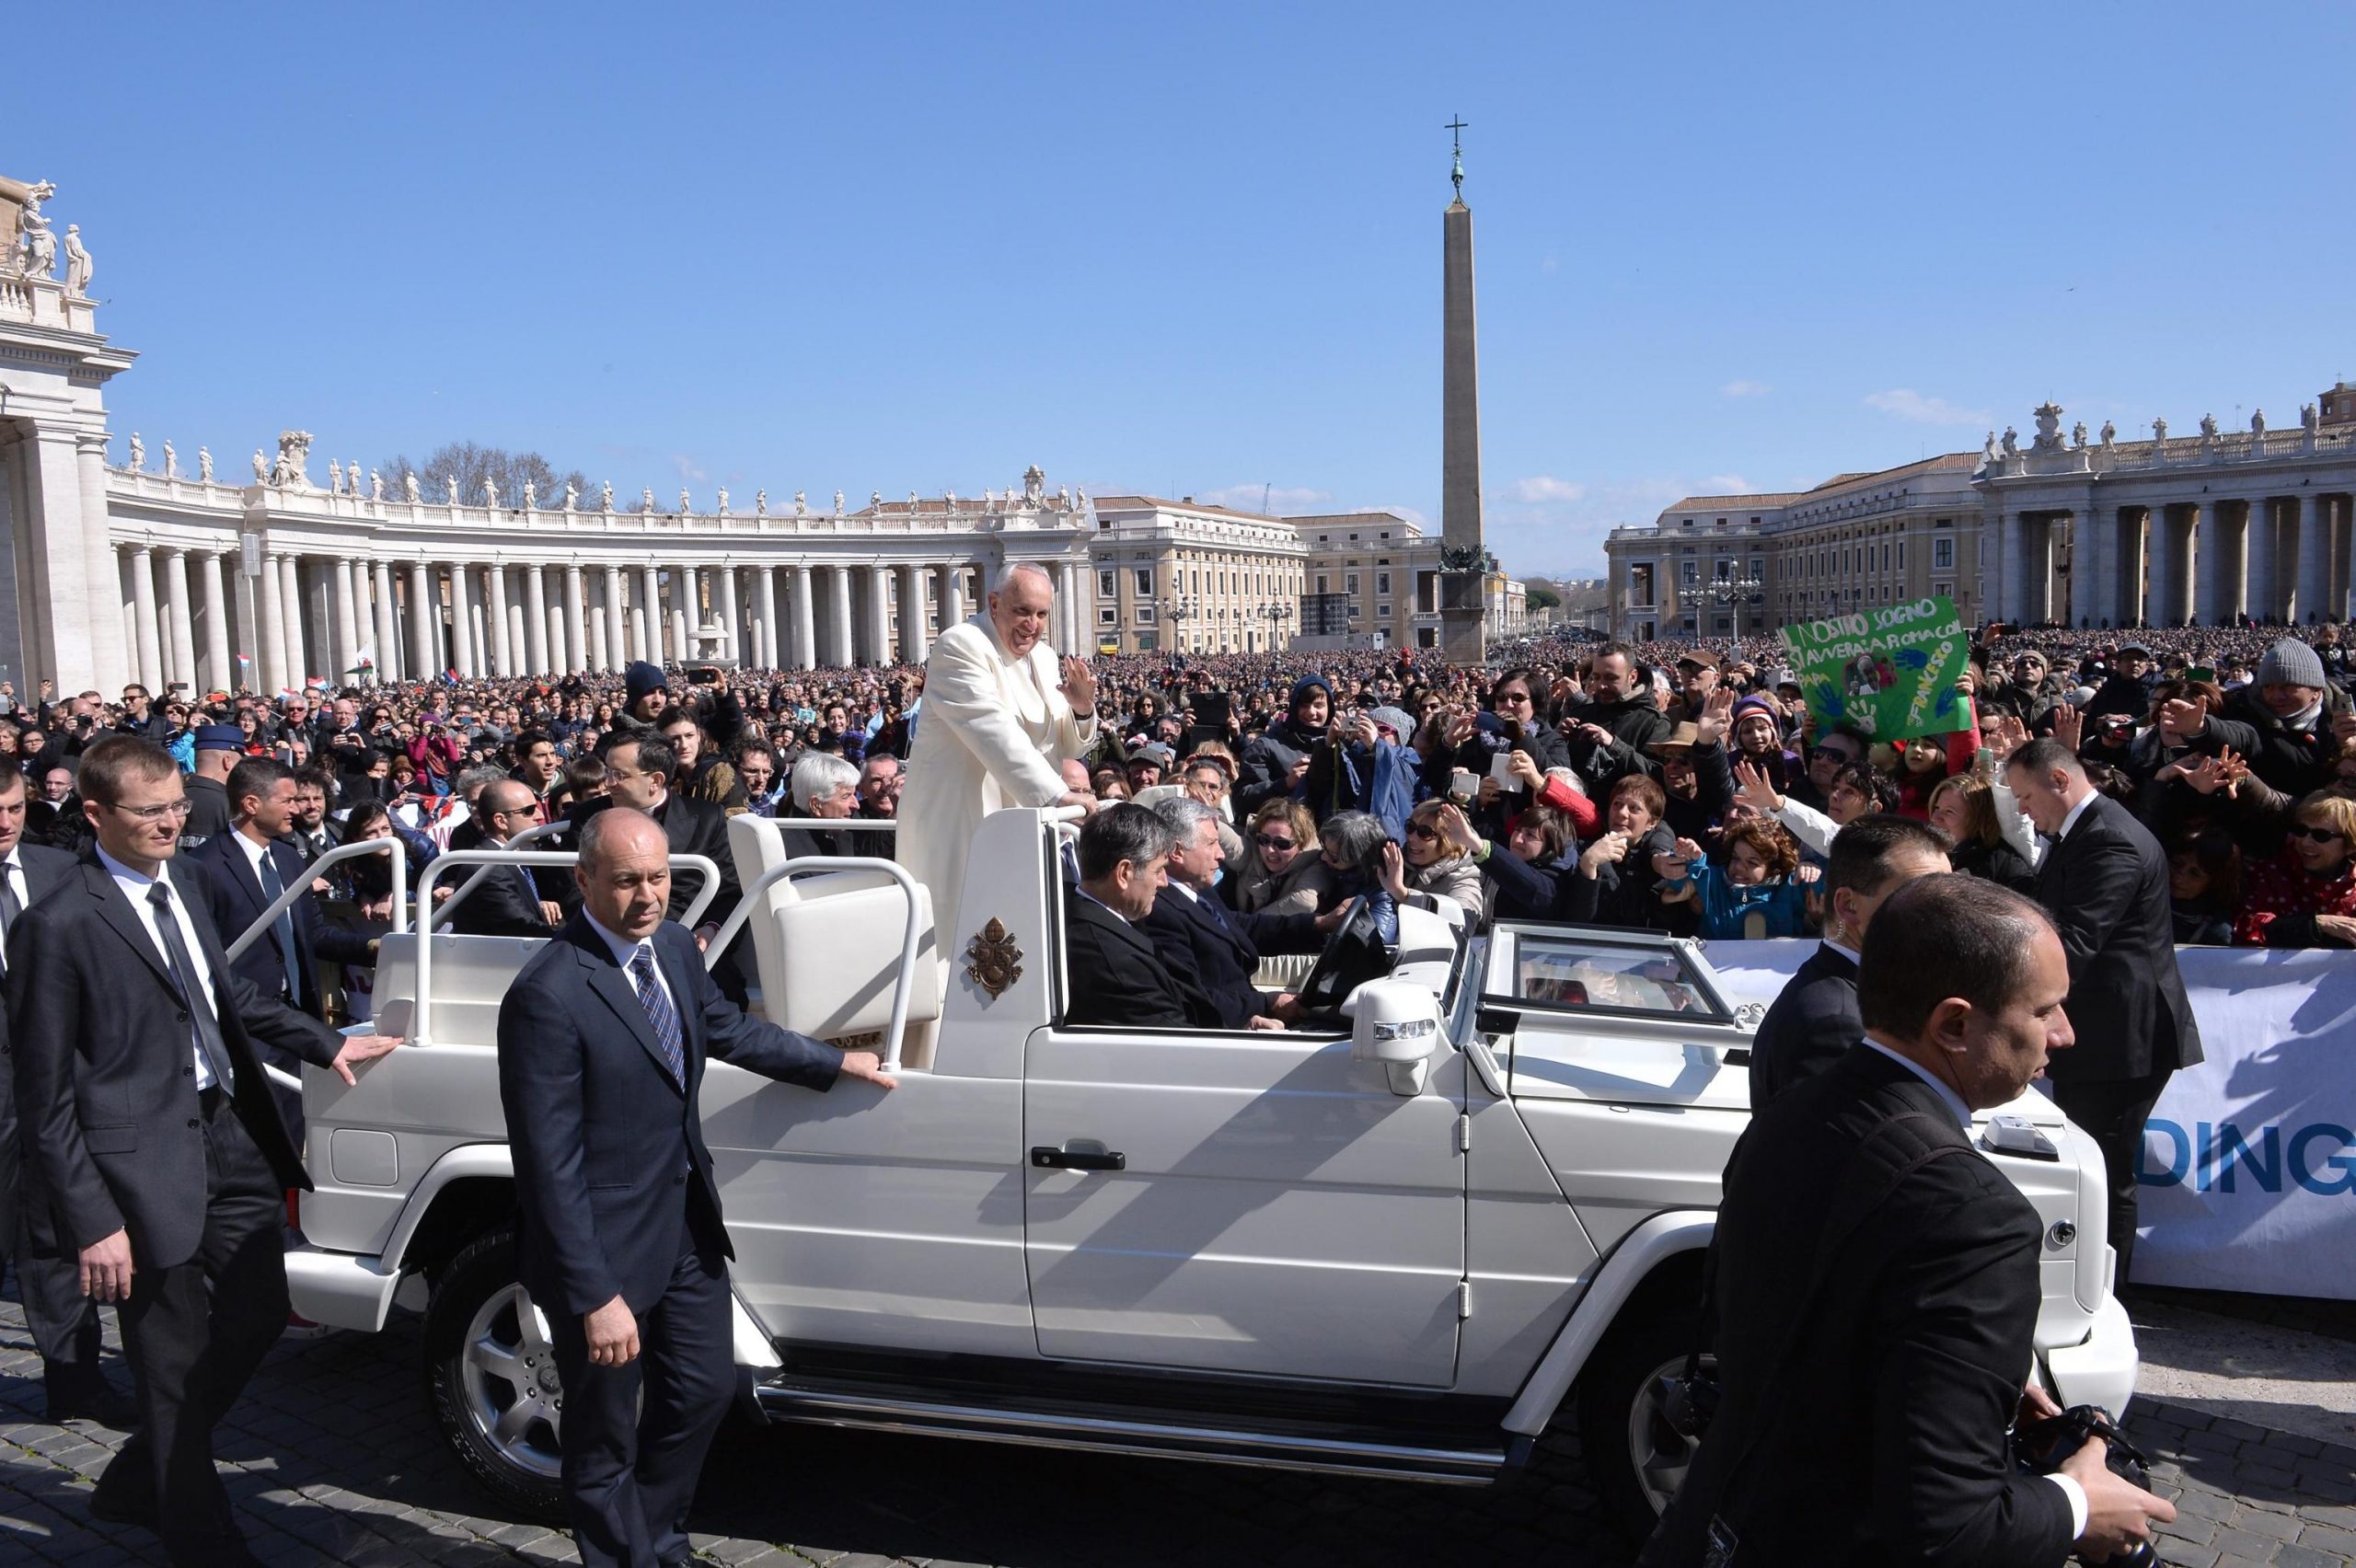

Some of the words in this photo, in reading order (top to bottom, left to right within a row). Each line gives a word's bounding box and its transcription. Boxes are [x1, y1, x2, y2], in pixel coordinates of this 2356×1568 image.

[1789, 647, 1805, 672] SI
[1886, 629, 1935, 650] ROMA
[1935, 619, 1962, 639] CON
[1797, 614, 1868, 646] NOSTRO
[1874, 598, 1937, 630] SOGNO
[1796, 672, 1831, 689] PAPA
[2134, 1118, 2356, 1196] DING
